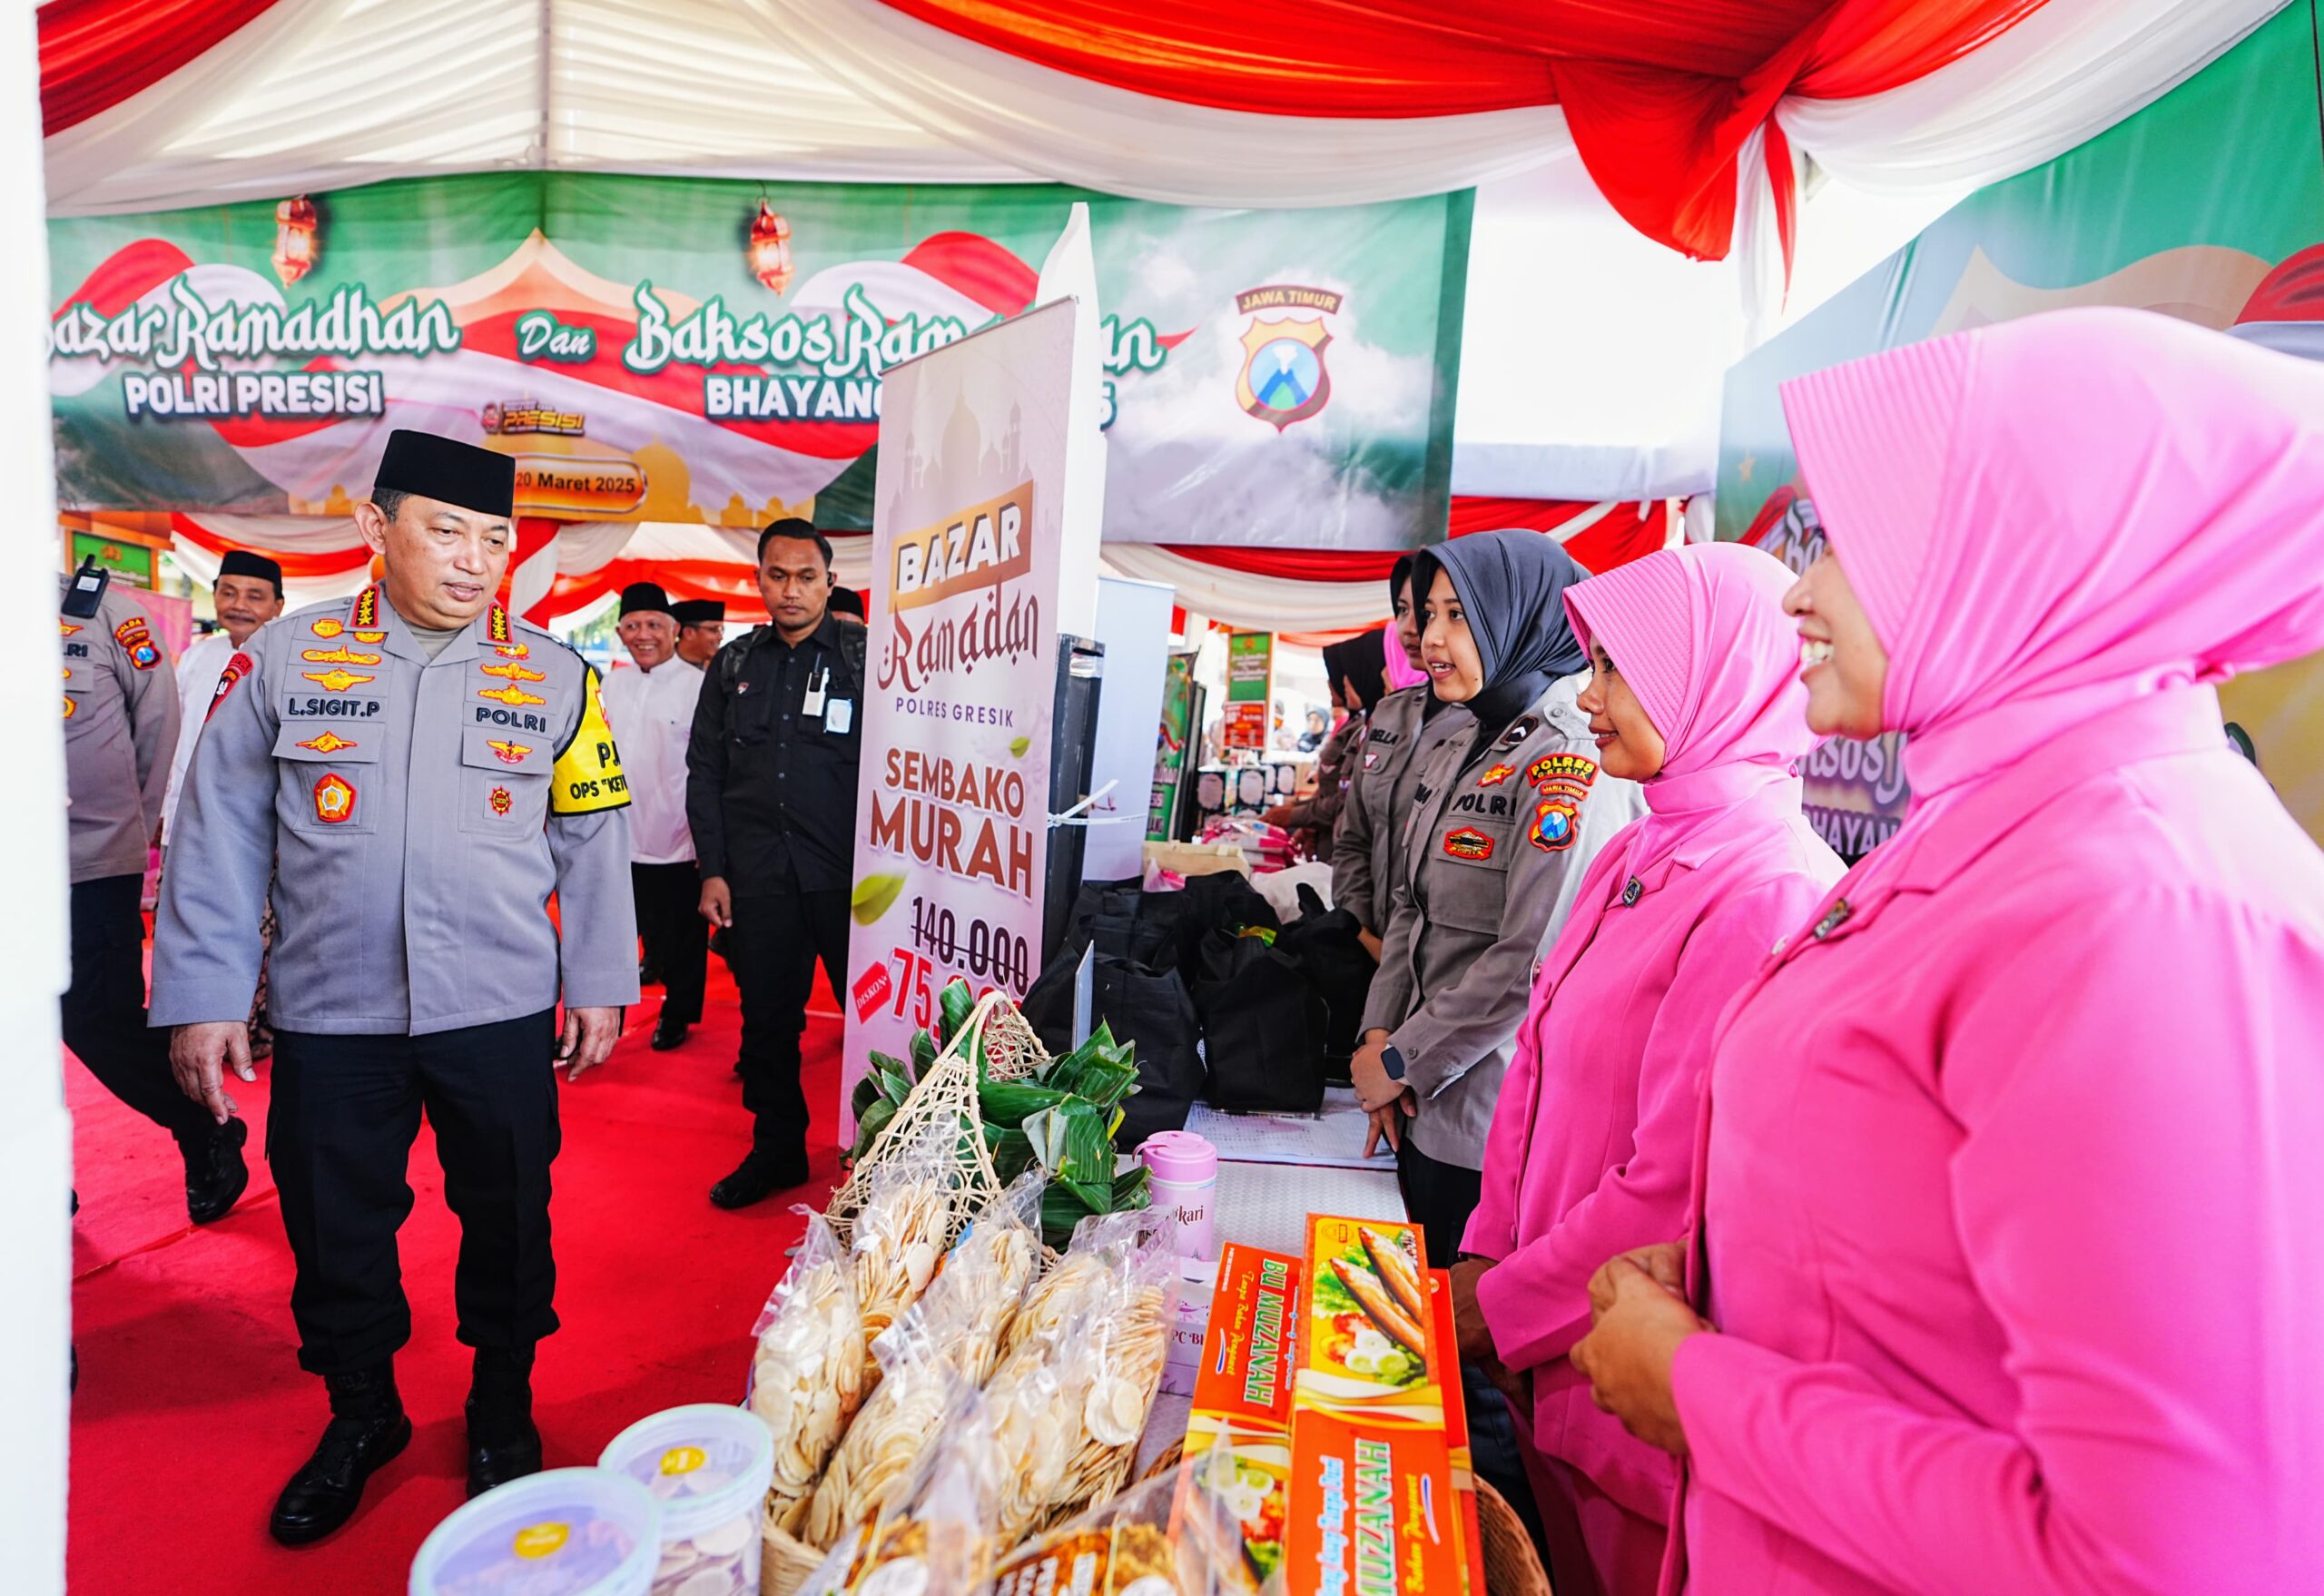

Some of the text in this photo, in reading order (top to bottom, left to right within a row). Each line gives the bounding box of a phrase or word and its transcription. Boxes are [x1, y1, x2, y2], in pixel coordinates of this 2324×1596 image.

[1243, 290, 1337, 310] JAWA TIMUR
[50, 303, 167, 358] azar
[154, 279, 461, 370] Ramadhan
[519, 314, 592, 358] Dan
[623, 283, 833, 372] Baksos
[124, 371, 881, 420] POLRI PRESISI BHAYAN
[504, 410, 585, 430] PRESISI
[516, 471, 635, 494] 20 Maret 2025
[896, 501, 1022, 596] BAZAR
[877, 576, 1039, 693] Ramadan
[288, 697, 547, 734] L.SIGIT.P POLRI
[896, 696, 1014, 727] POLRES GRESIK
[1531, 756, 1595, 776] POLRES
[1538, 767, 1587, 779] GRESIK
[570, 780, 600, 800] OPS
[885, 747, 1025, 818] SEMBAKO
[1543, 784, 1585, 798] JAWA TIMUR
[869, 789, 1033, 899] MURAH
[911, 895, 1029, 997] 140.000
[856, 980, 886, 1009] DISKON
[1233, 1303, 1249, 1330] Bahan
[1243, 1258, 1288, 1408] BU MUZANAH
